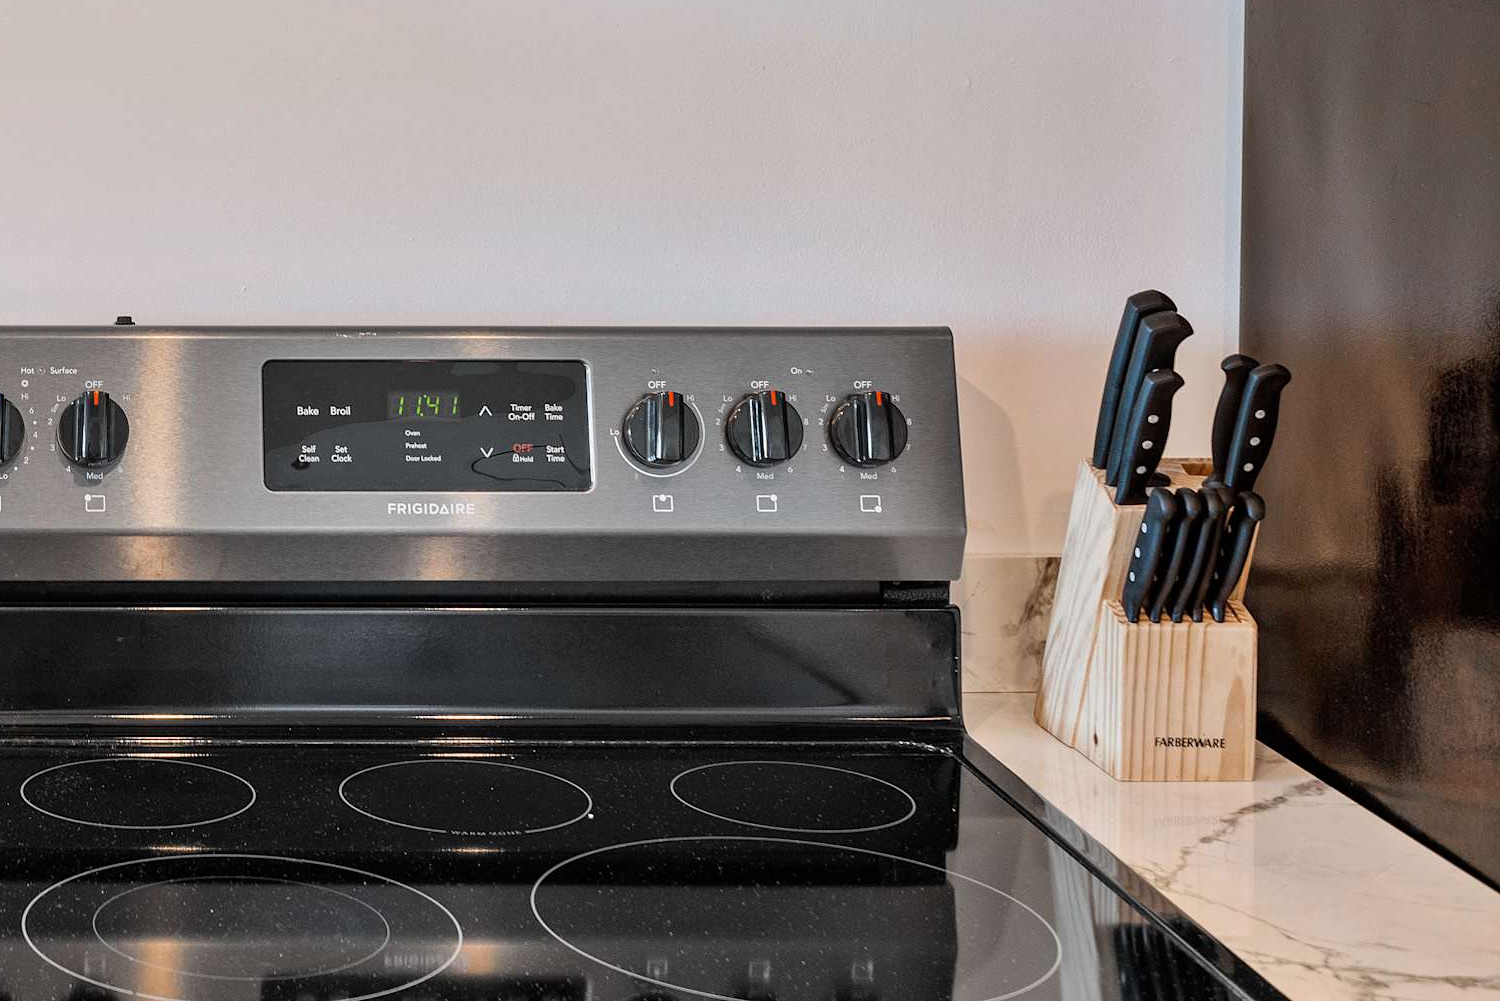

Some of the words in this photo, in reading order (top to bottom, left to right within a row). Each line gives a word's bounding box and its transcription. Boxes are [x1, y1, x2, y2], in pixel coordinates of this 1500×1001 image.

[50, 366, 78, 375] Surface
[790, 366, 803, 374] On
[85, 380, 103, 389] OFF
[648, 380, 667, 389] OFF
[750, 380, 769, 389] OFF
[853, 380, 872, 389] OFF
[686, 394, 695, 402] Hi
[297, 406, 319, 416] Bake
[330, 406, 351, 416] Broil
[510, 403, 532, 412] Timer
[544, 403, 563, 412] Bake
[508, 412, 535, 421] On-Off
[544, 412, 564, 421] Time
[405, 429, 421, 437] Oven
[609, 428, 620, 436] Lo
[301, 445, 317, 454] Self
[334, 445, 348, 454] Set
[512, 443, 533, 453] OFF
[546, 445, 564, 454] Start
[298, 454, 320, 463] Clean
[331, 454, 352, 463] Clock
[421, 455, 442, 463] Locked
[520, 455, 534, 463] Hold
[546, 454, 565, 463] Time
[86, 472, 104, 480] Med
[756, 472, 774, 480] Med
[860, 472, 878, 480] Med
[387, 502, 475, 515] FRIGIDAIRE
[1154, 736, 1226, 749] FARBERWARE
